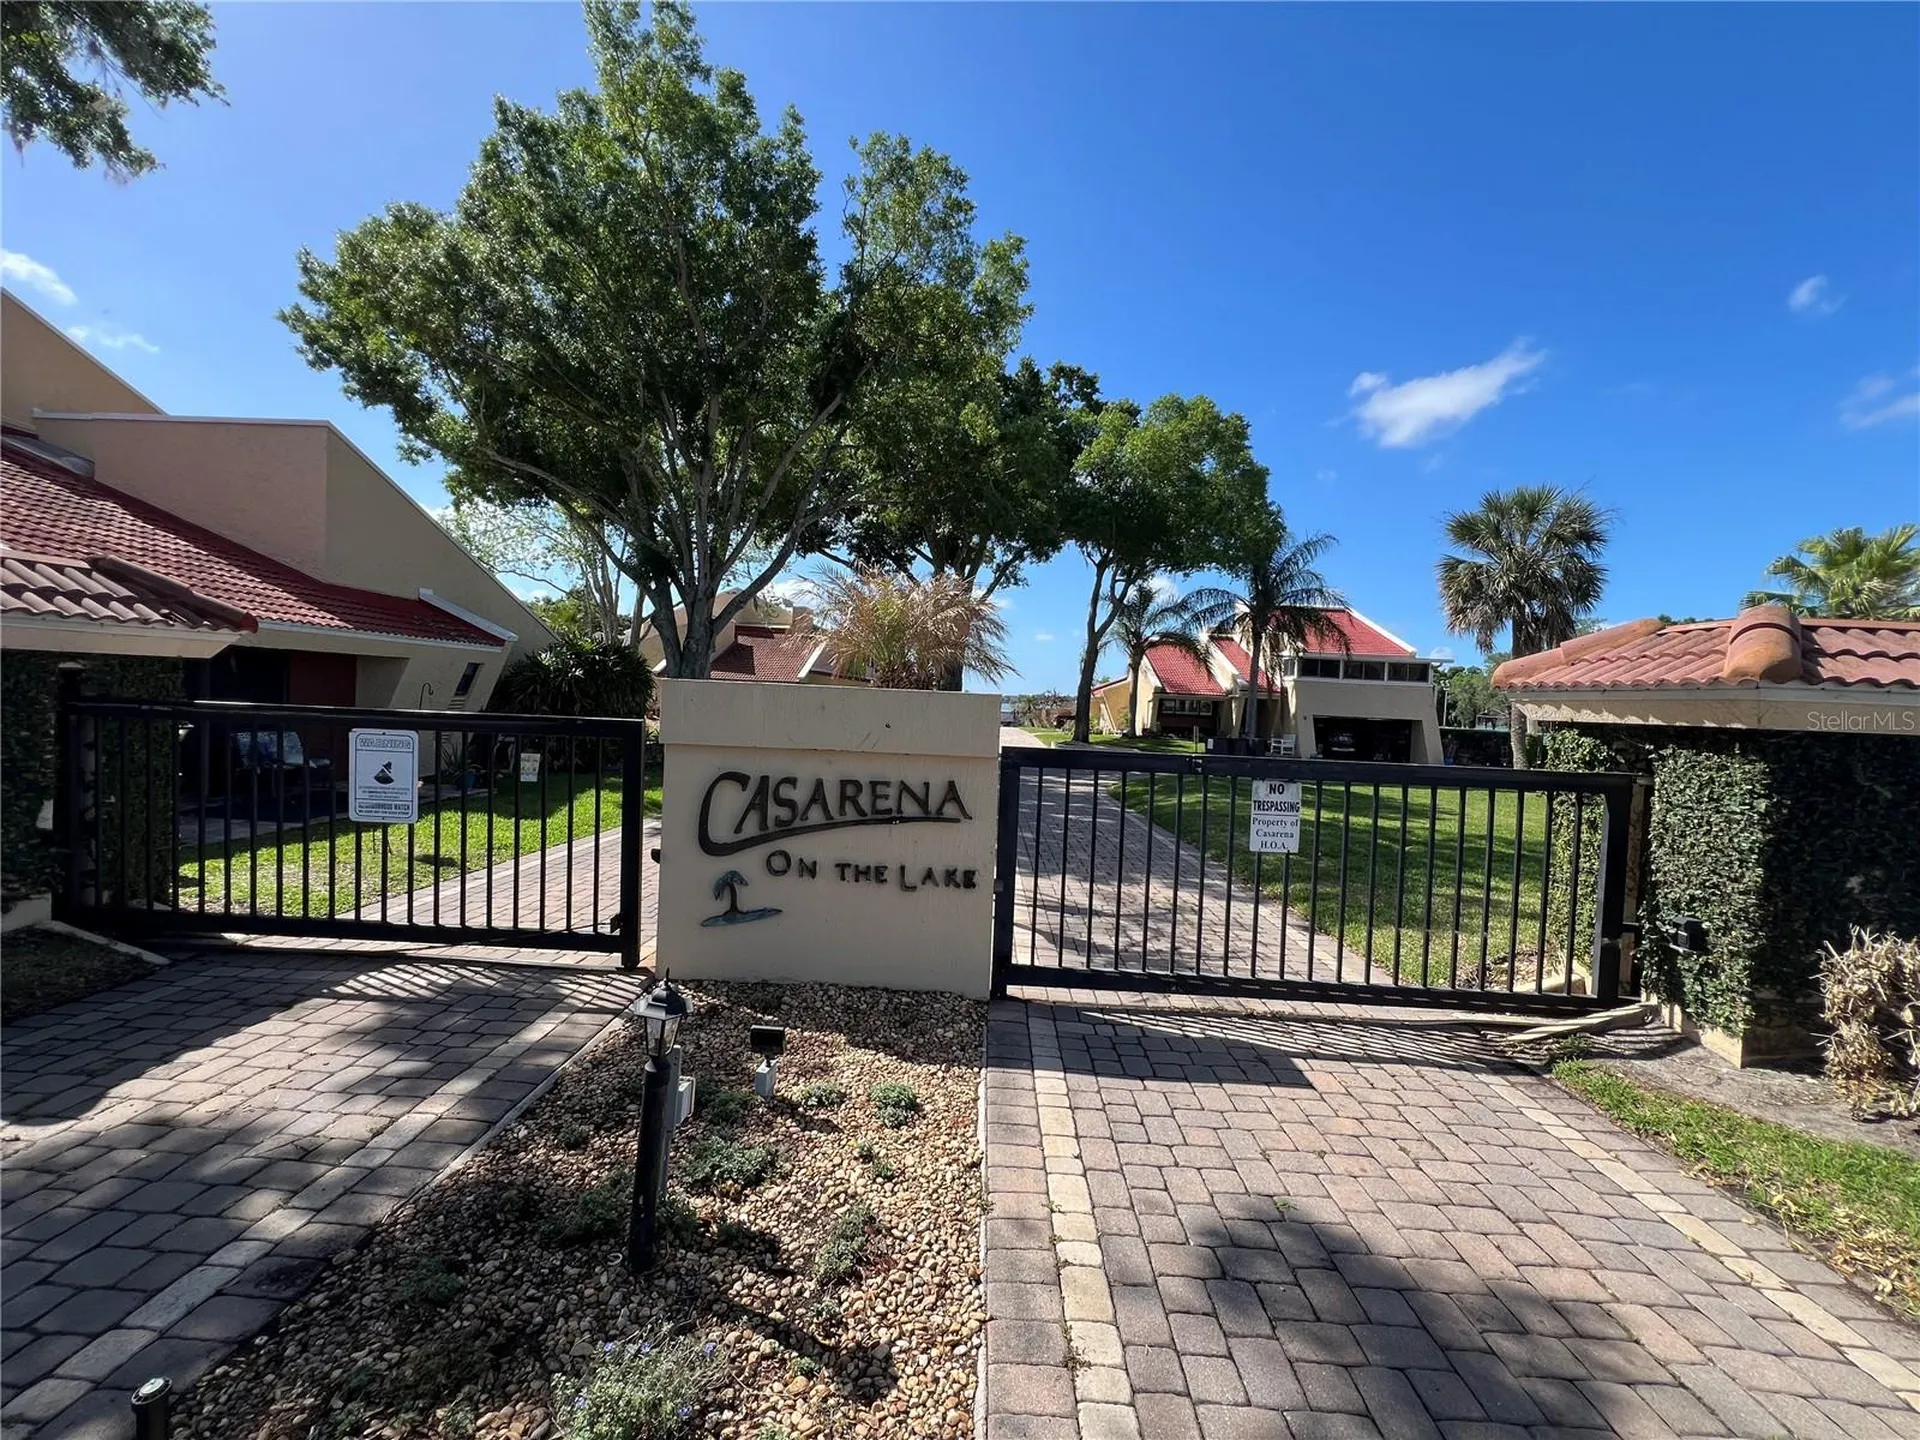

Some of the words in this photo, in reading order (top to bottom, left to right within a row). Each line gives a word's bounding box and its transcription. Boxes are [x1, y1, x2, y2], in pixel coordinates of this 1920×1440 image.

[1269, 783, 1285, 795] NO
[1253, 800, 1300, 813] TRESPASSING
[698, 771, 973, 857] CASARENA
[1252, 817, 1287, 828] Property
[1290, 819, 1299, 827] of
[1255, 828, 1294, 838] Casarena
[834, 862, 889, 884] THE
[899, 864, 978, 892] LAKE
